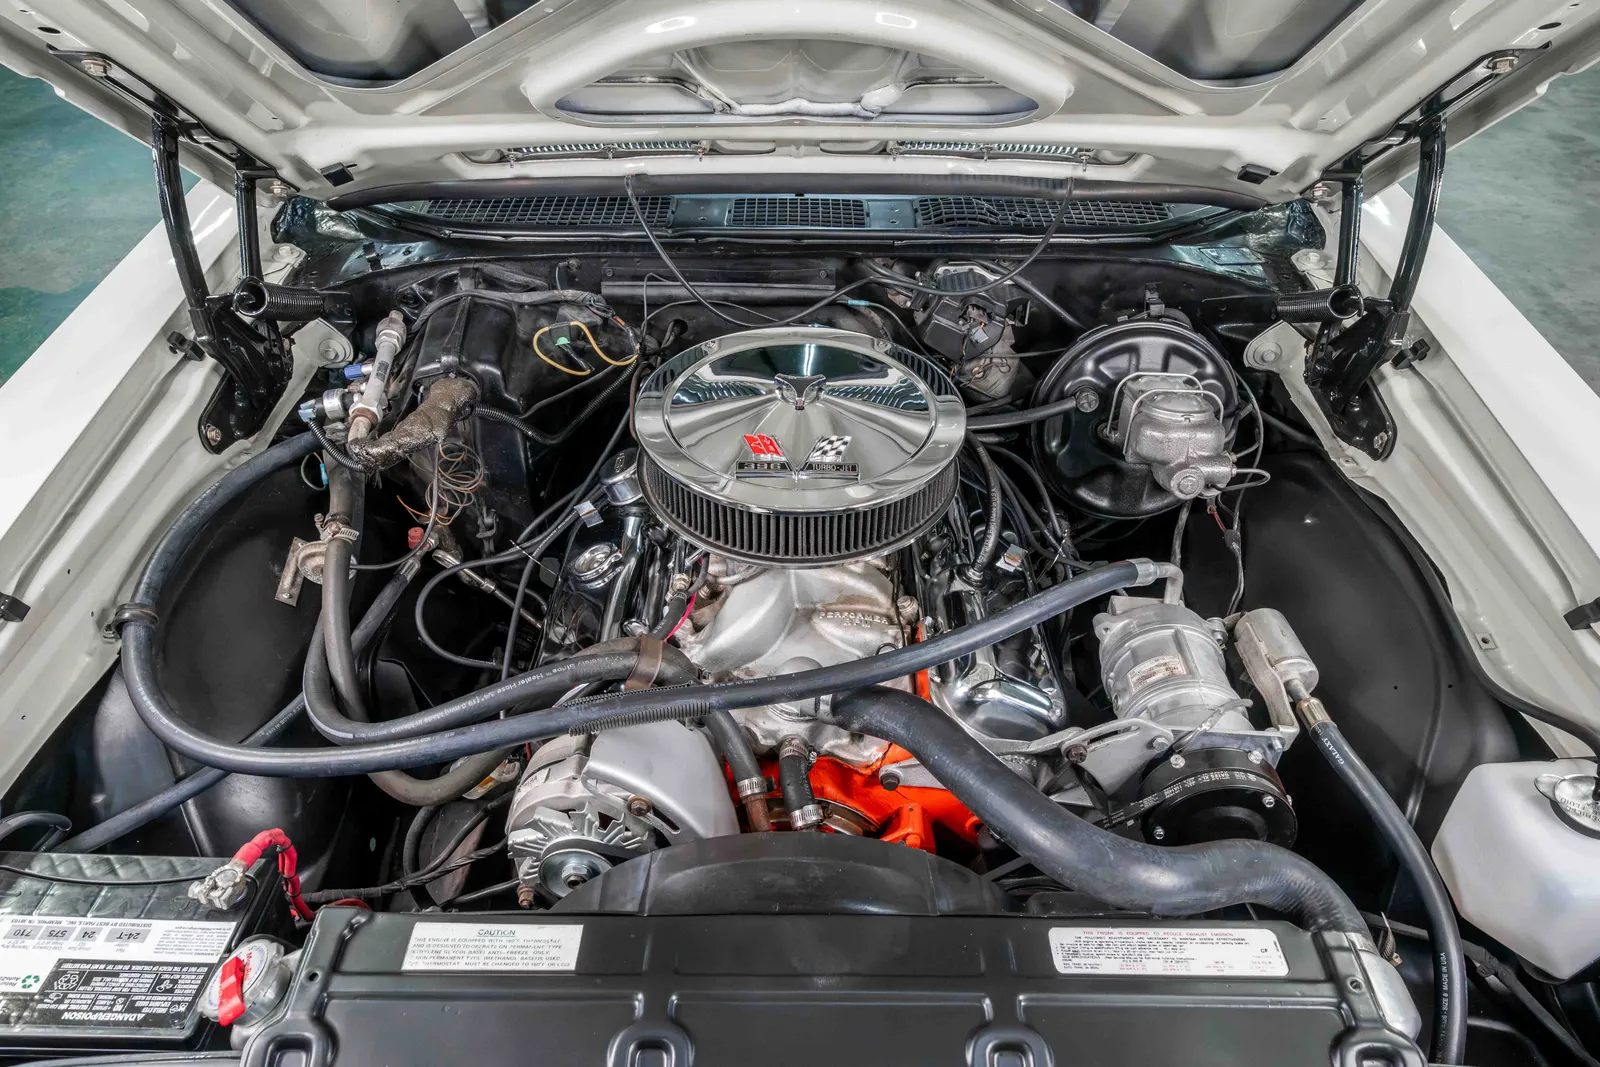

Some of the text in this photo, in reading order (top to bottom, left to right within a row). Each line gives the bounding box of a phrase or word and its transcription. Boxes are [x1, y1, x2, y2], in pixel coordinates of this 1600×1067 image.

[744, 462, 780, 470] 396
[812, 464, 854, 472] TURBO-JET
[844, 619, 871, 628] RPM
[518, 673, 544, 686] Heater
[497, 681, 516, 693] Hose
[423, 712, 443, 723] Made
[390, 722, 416, 734] Mexico
[1323, 738, 1344, 764] GALAXY
[1560, 798, 1586, 811] FLUID
[13, 929, 33, 937] 710
[48, 930, 67, 938] 575
[116, 932, 141, 940] 24-T
[61, 1012, 136, 1021] DANGER/POISON
